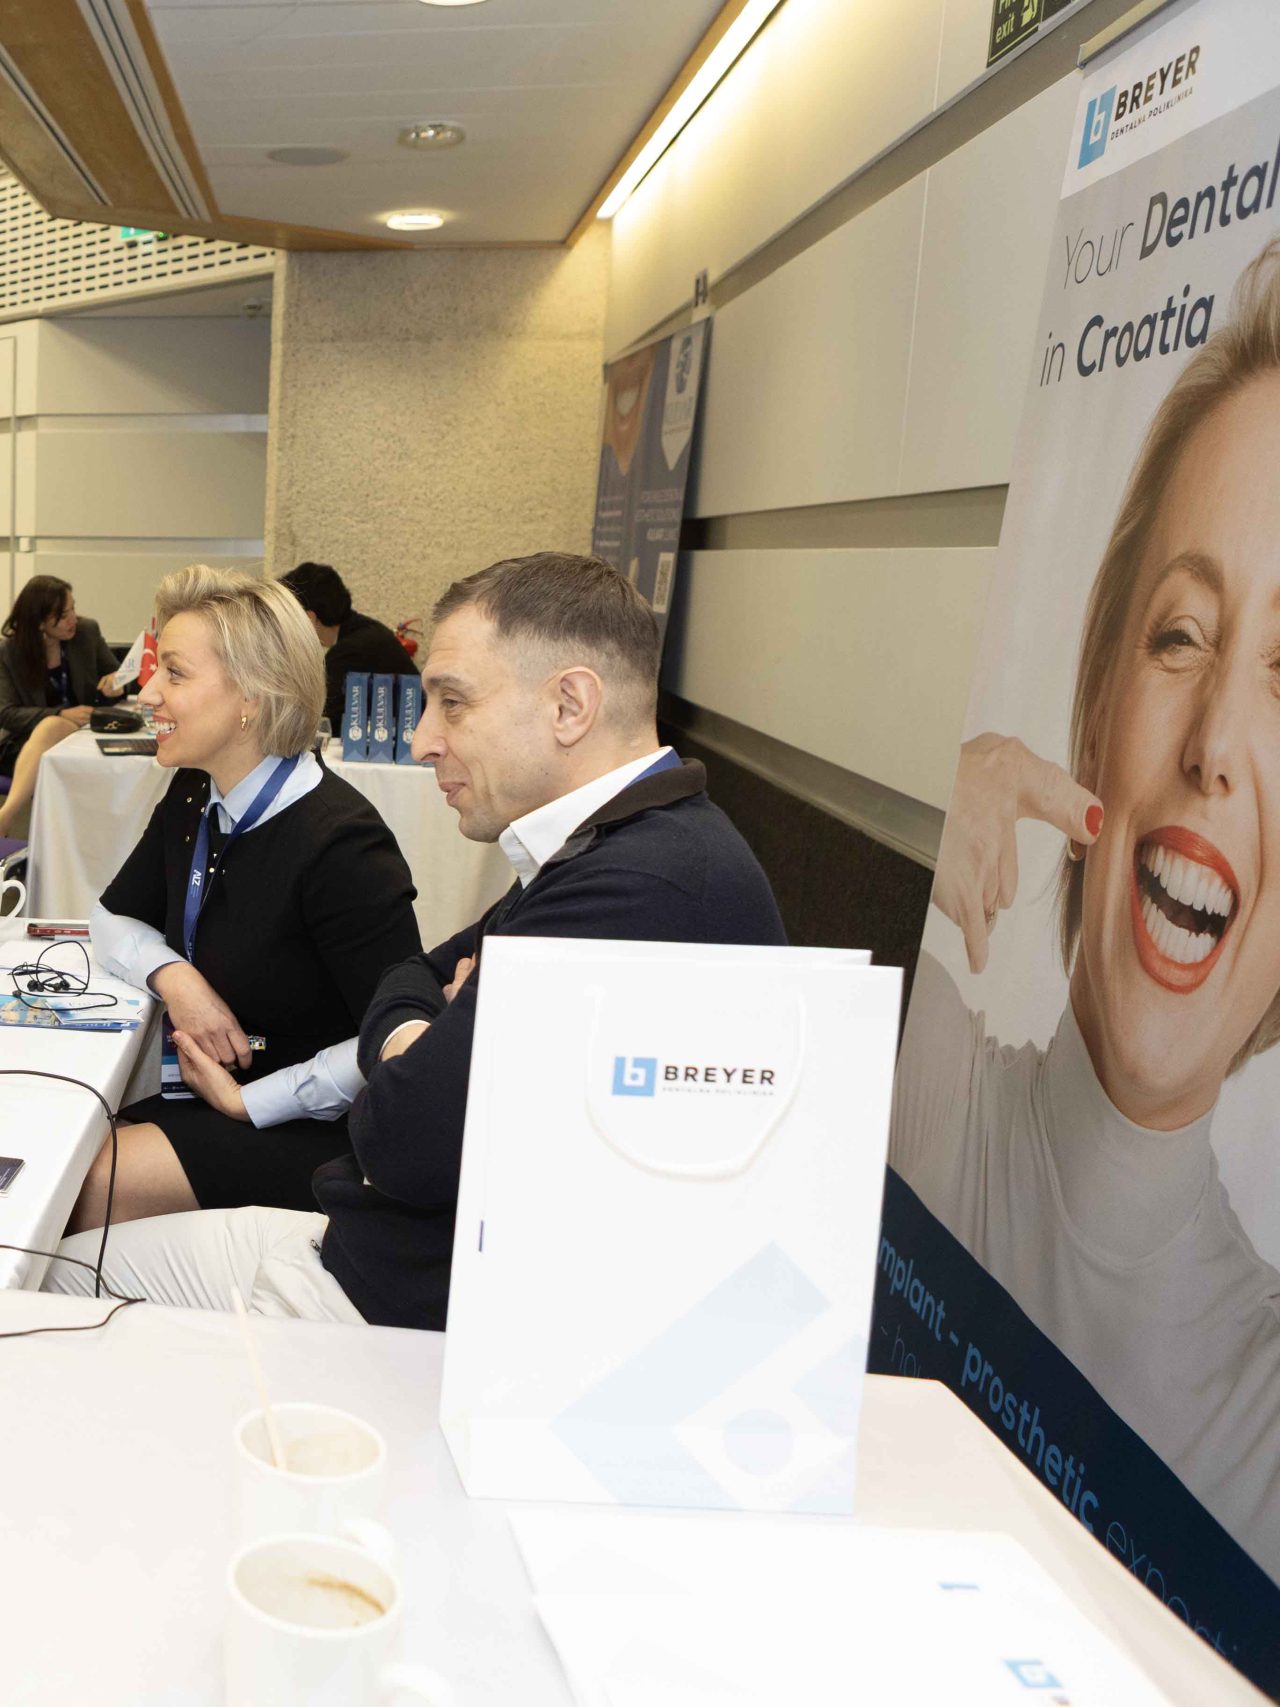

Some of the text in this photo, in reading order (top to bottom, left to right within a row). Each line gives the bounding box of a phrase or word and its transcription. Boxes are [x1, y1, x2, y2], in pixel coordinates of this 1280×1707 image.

[995, 12, 1015, 43] exit
[1110, 87, 1193, 141] DENTALNA POLIKLINIKA
[1114, 45, 1200, 122] BREYER
[1064, 136, 1280, 290] Your Dental
[1039, 283, 1216, 388] in Croatia
[663, 1065, 775, 1085] BREYER
[960, 1342, 1100, 1533] prosthetic
